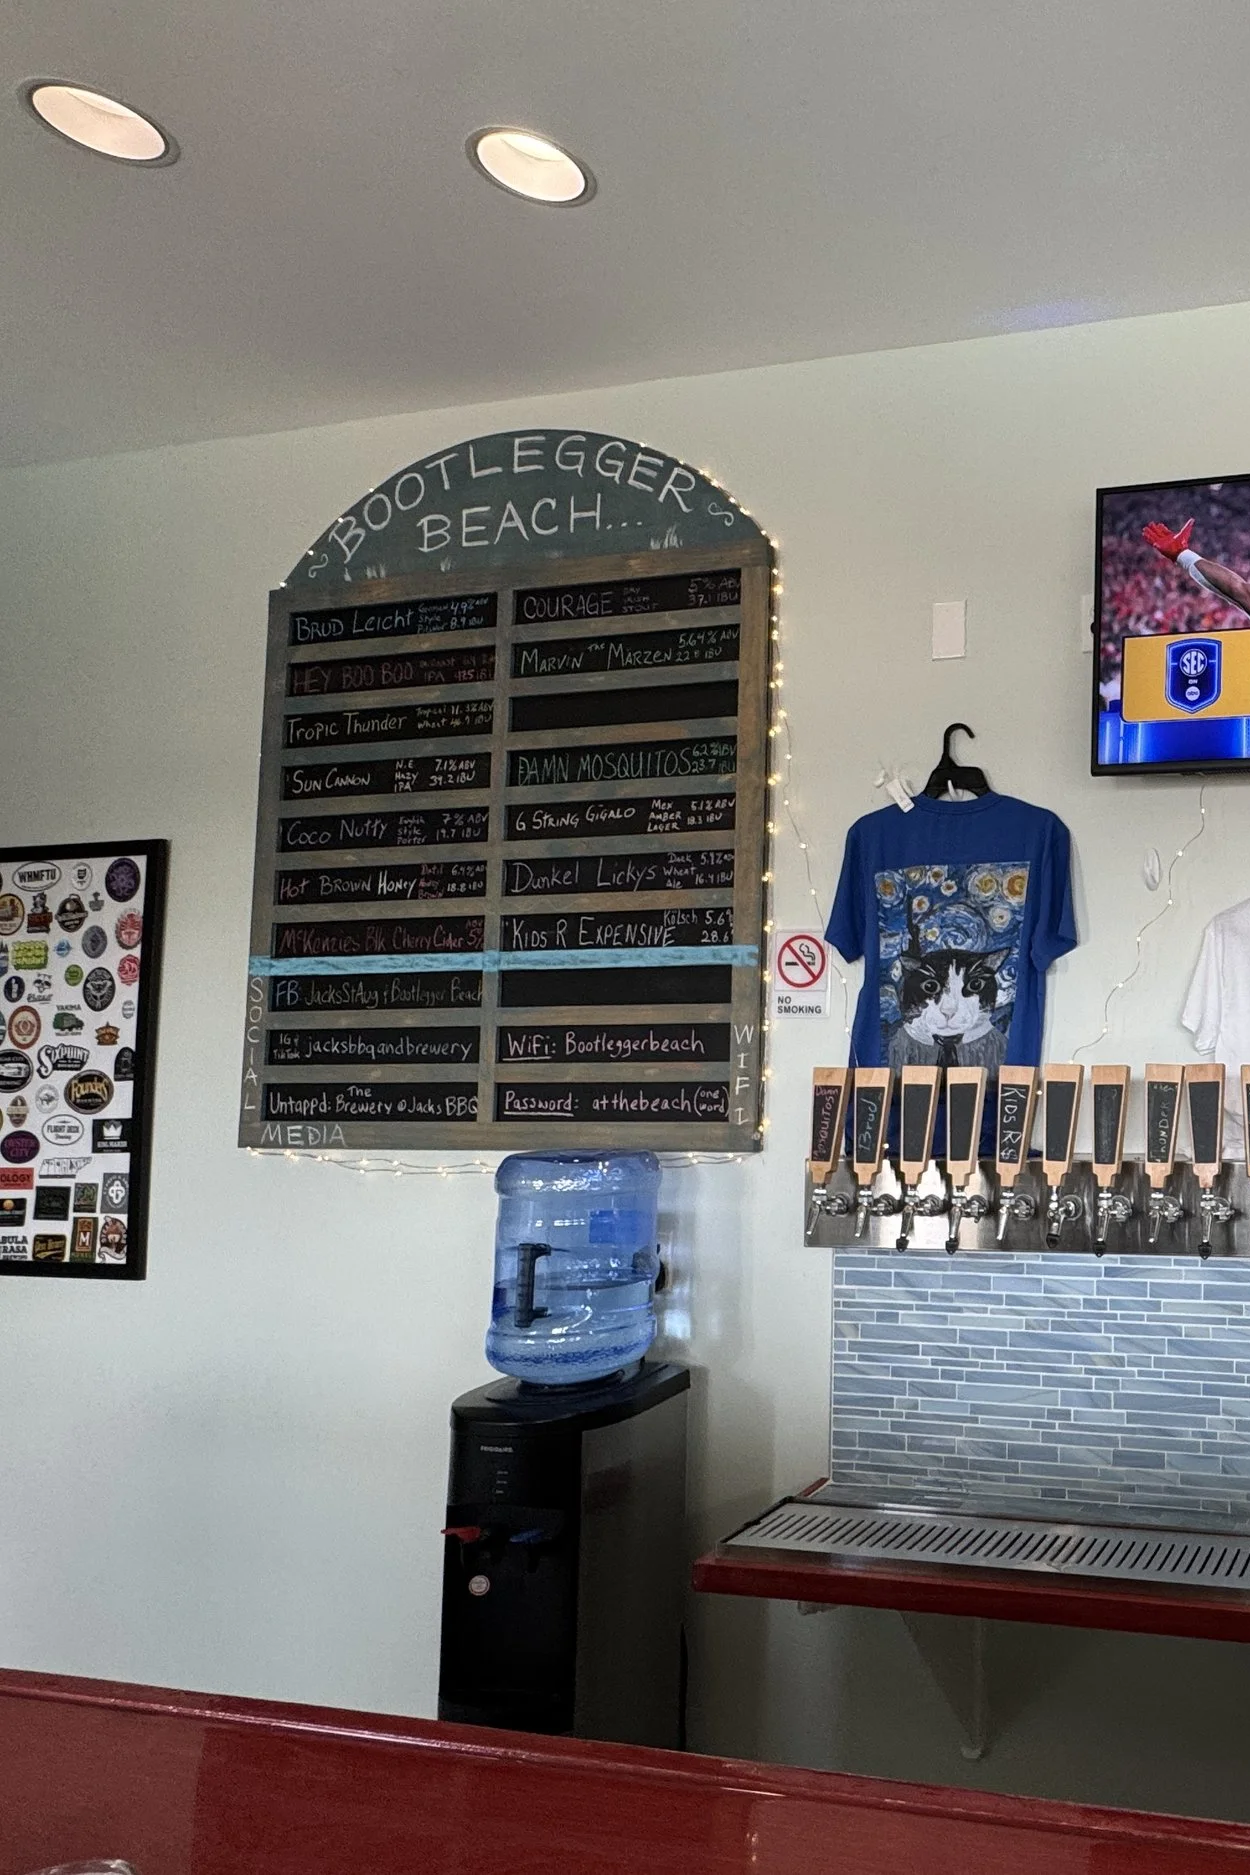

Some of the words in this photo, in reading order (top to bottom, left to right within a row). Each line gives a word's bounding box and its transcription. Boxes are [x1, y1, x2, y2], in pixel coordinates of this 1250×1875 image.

[328, 435, 696, 563] BOOTLEGGER
[523, 591, 615, 620] COURAGE
[295, 616, 344, 642] BRUD
[520, 648, 585, 676] MARVIN
[1182, 650, 1205, 675] SEC
[293, 666, 332, 694] HEY
[342, 664, 375, 689] BOO
[379, 661, 415, 686] BOO
[342, 711, 408, 735] Thunder
[291, 769, 323, 794] SUN
[325, 767, 371, 789] CANNON
[517, 753, 570, 786] DAMN
[577, 747, 693, 782] MOSQUITOS
[287, 820, 332, 846] Coco
[339, 818, 389, 841] Nutty
[319, 874, 372, 896] BROWN
[510, 860, 580, 893] Dunkel
[596, 857, 659, 892] Lickys
[556, 917, 568, 948] R
[578, 916, 677, 948] EXPENSIVE
[777, 1005, 822, 1014] SMOKING
[778, 996, 792, 1005] NO
[244, 976, 264, 1110] SOCIAL
[305, 1034, 473, 1061] jacksbbqandbrewery
[565, 1029, 706, 1058] Bootleggerbeach
[734, 1024, 755, 1126] WIFI
[335, 1093, 393, 1115] Brewery
[444, 1095, 479, 1117] BBQ
[1000, 1086, 1027, 1124] KIDS
[260, 1123, 350, 1148] MEDIA
[0, 1235, 29, 1245] BULA
